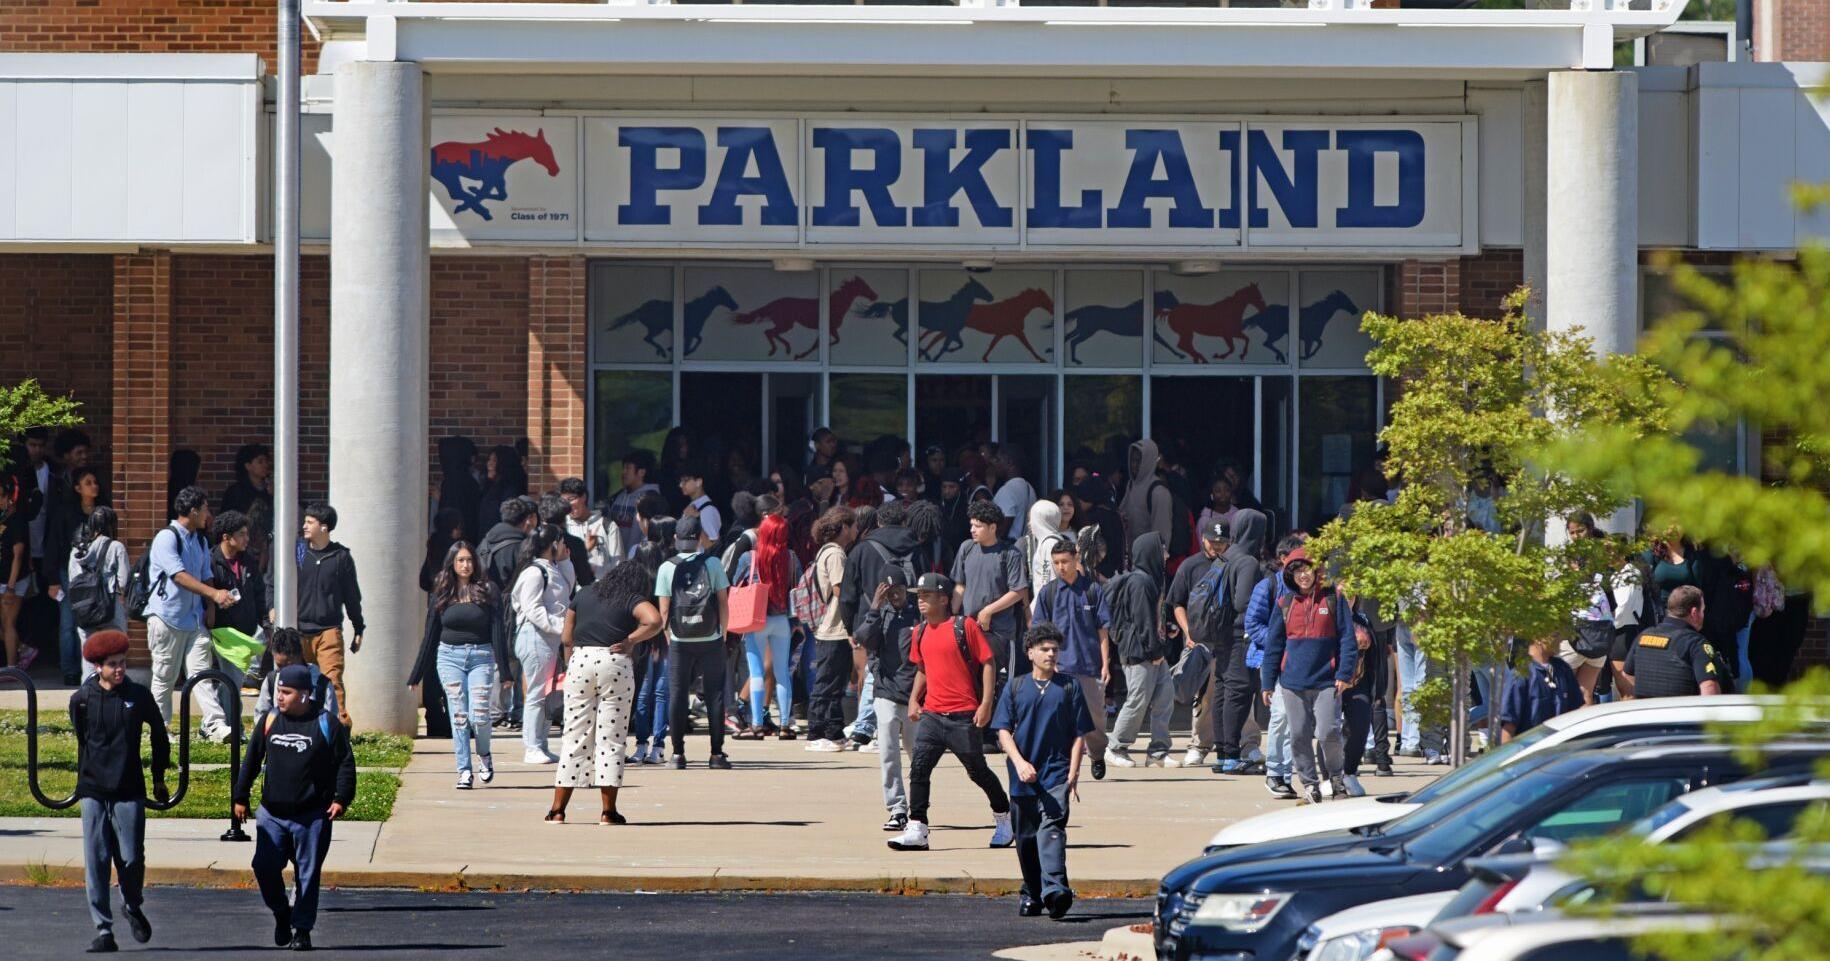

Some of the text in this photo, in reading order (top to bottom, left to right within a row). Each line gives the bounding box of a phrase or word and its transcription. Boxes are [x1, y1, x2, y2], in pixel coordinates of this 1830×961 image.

[618, 126, 1426, 229] PARKLAND
[511, 212, 569, 220] Class of 1971
